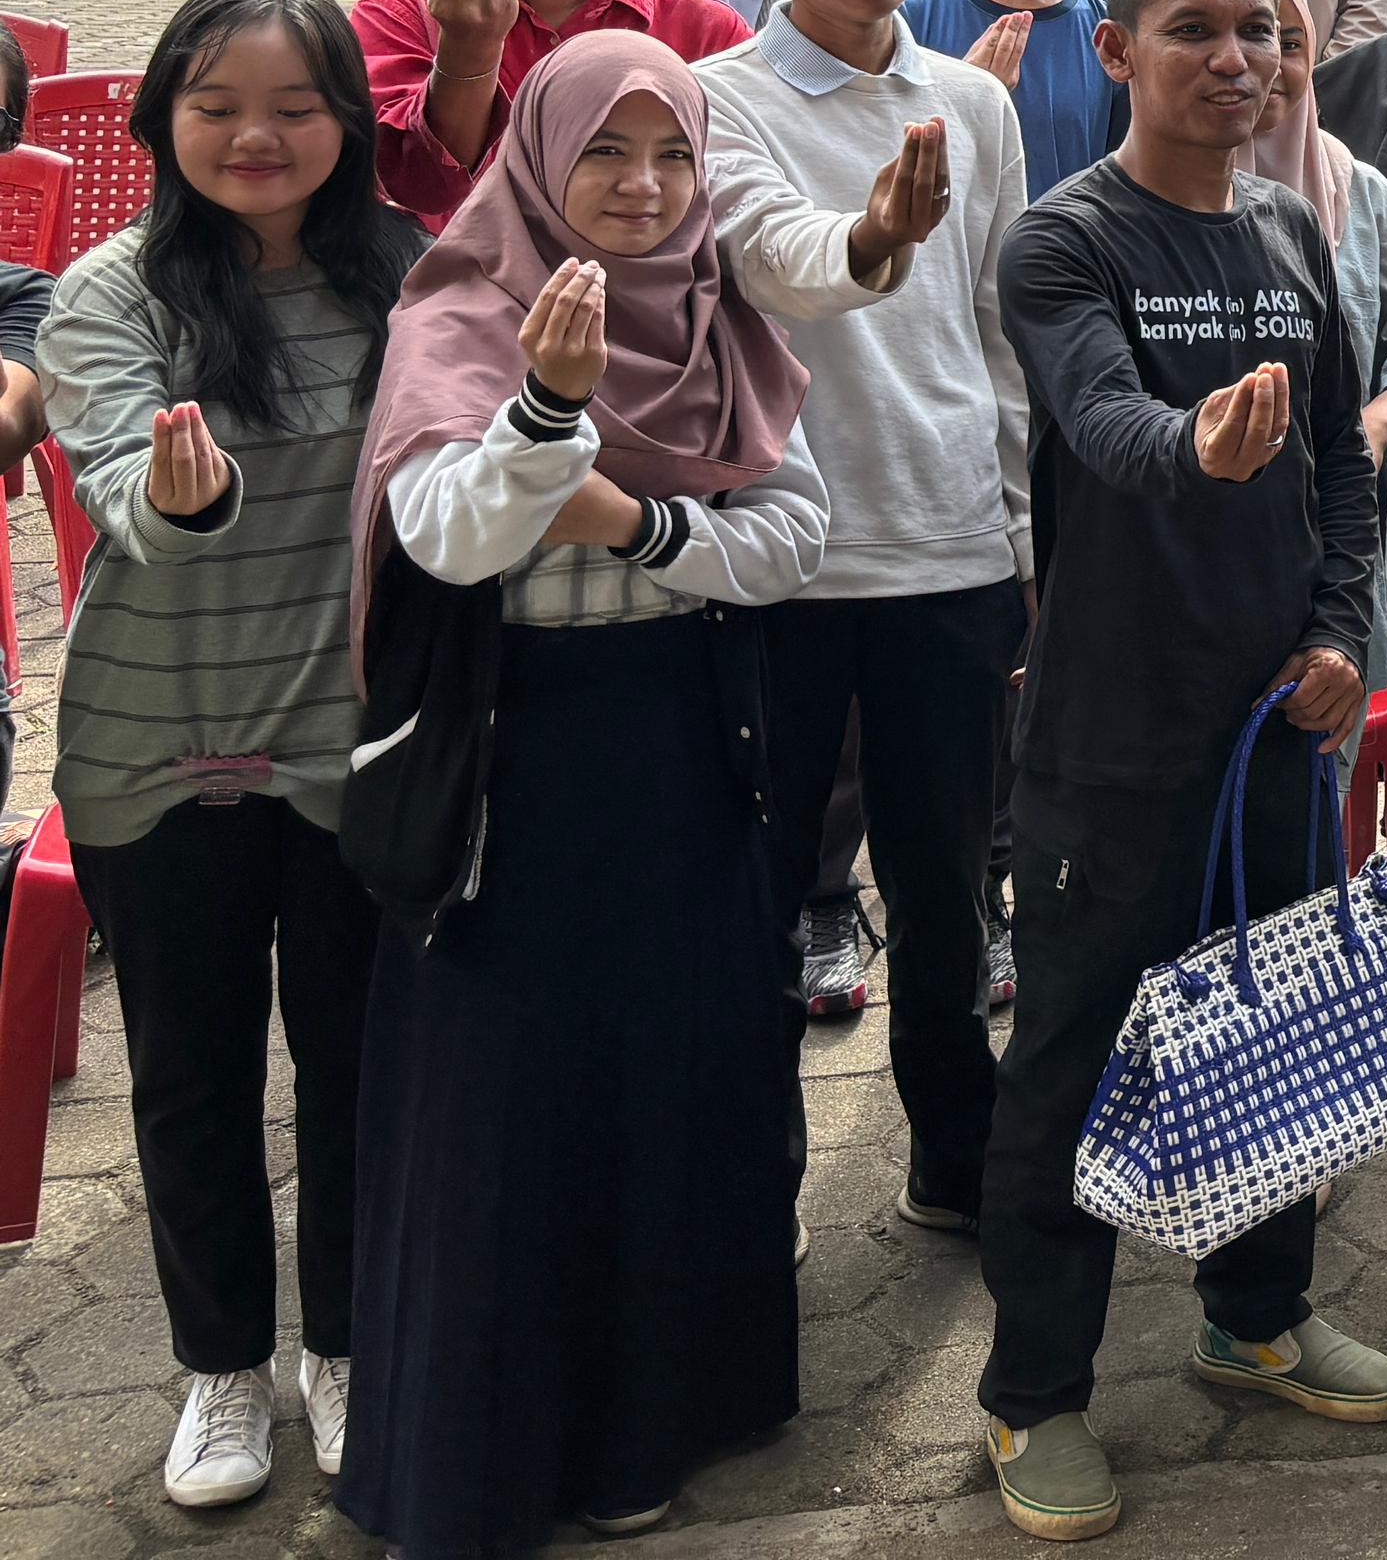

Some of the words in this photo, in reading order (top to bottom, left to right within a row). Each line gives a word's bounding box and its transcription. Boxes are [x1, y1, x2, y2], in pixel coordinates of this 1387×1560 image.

[1135, 288, 1222, 318] banyak
[1253, 289, 1301, 313] AKSI
[1138, 316, 1225, 345] banyak
